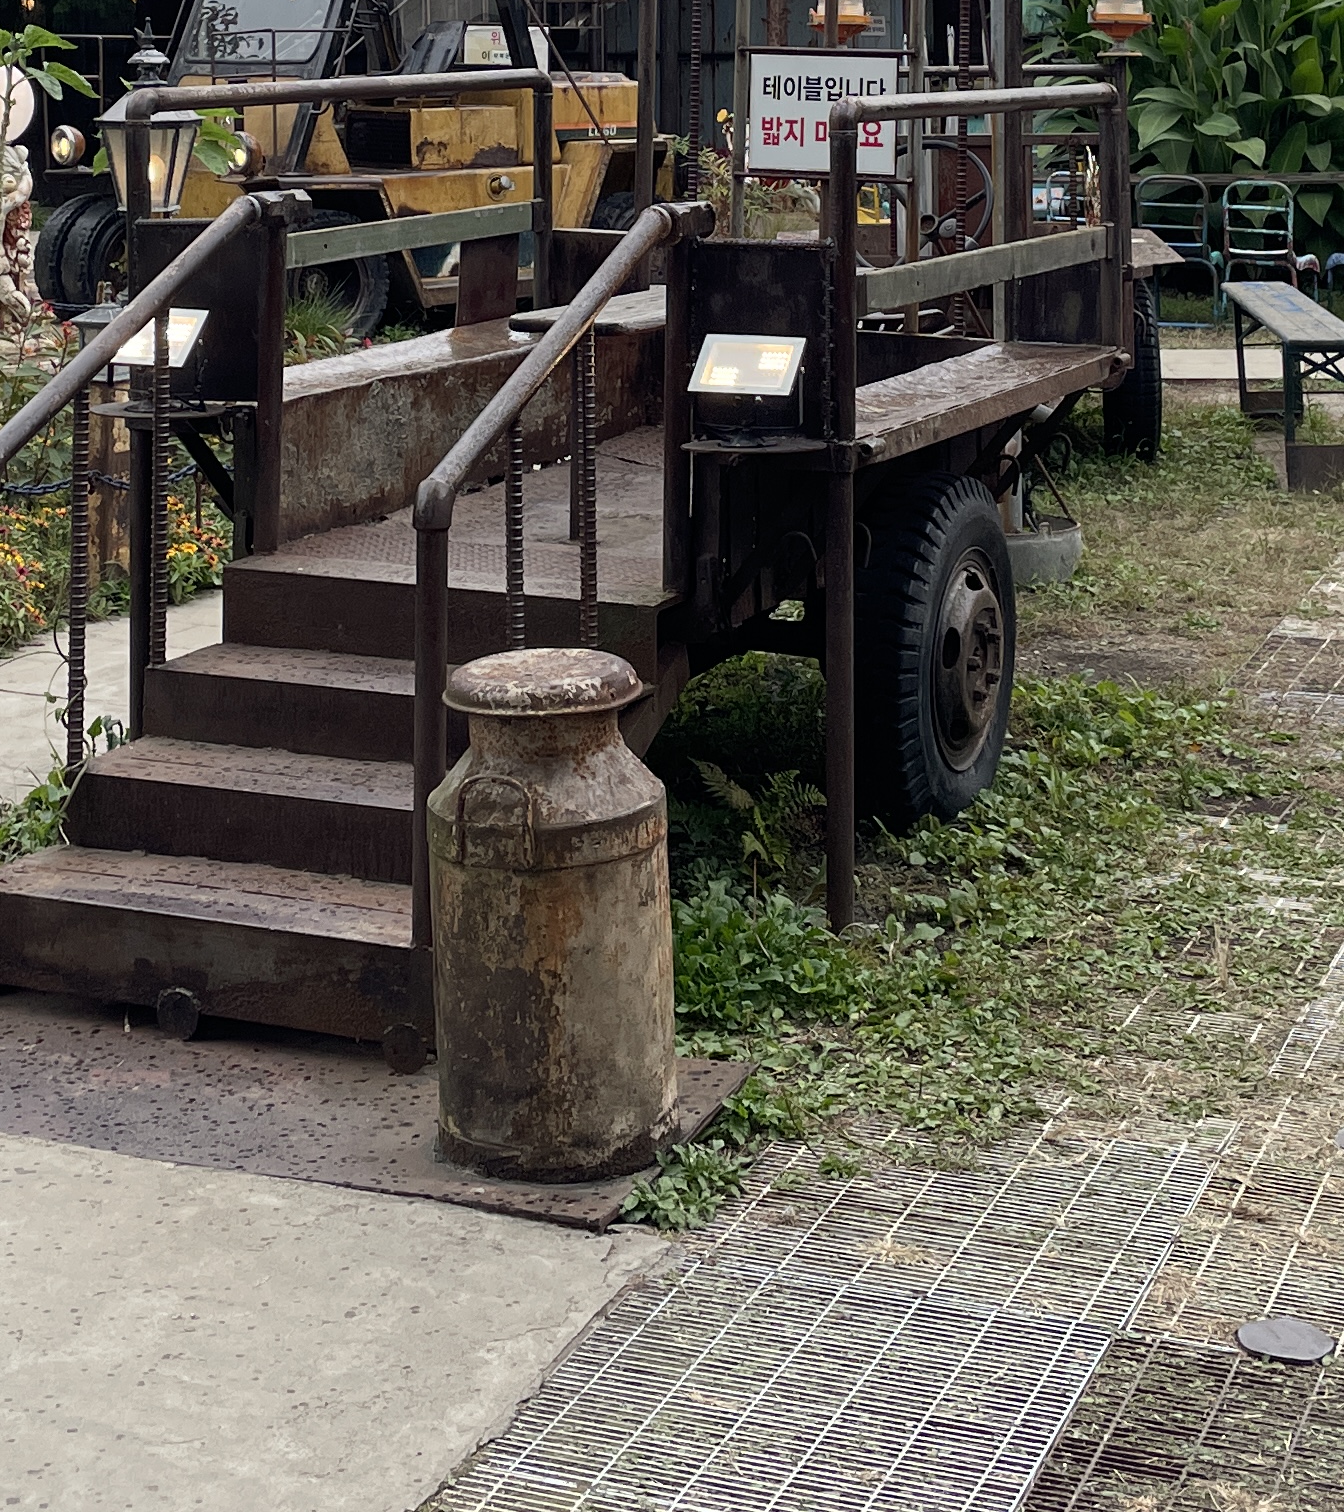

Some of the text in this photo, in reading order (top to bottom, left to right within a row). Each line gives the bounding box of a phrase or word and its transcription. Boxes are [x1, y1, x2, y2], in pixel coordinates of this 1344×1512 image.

[762, 74, 887, 102] 테이블입니다
[761, 116, 884, 148] 밟지 마요
